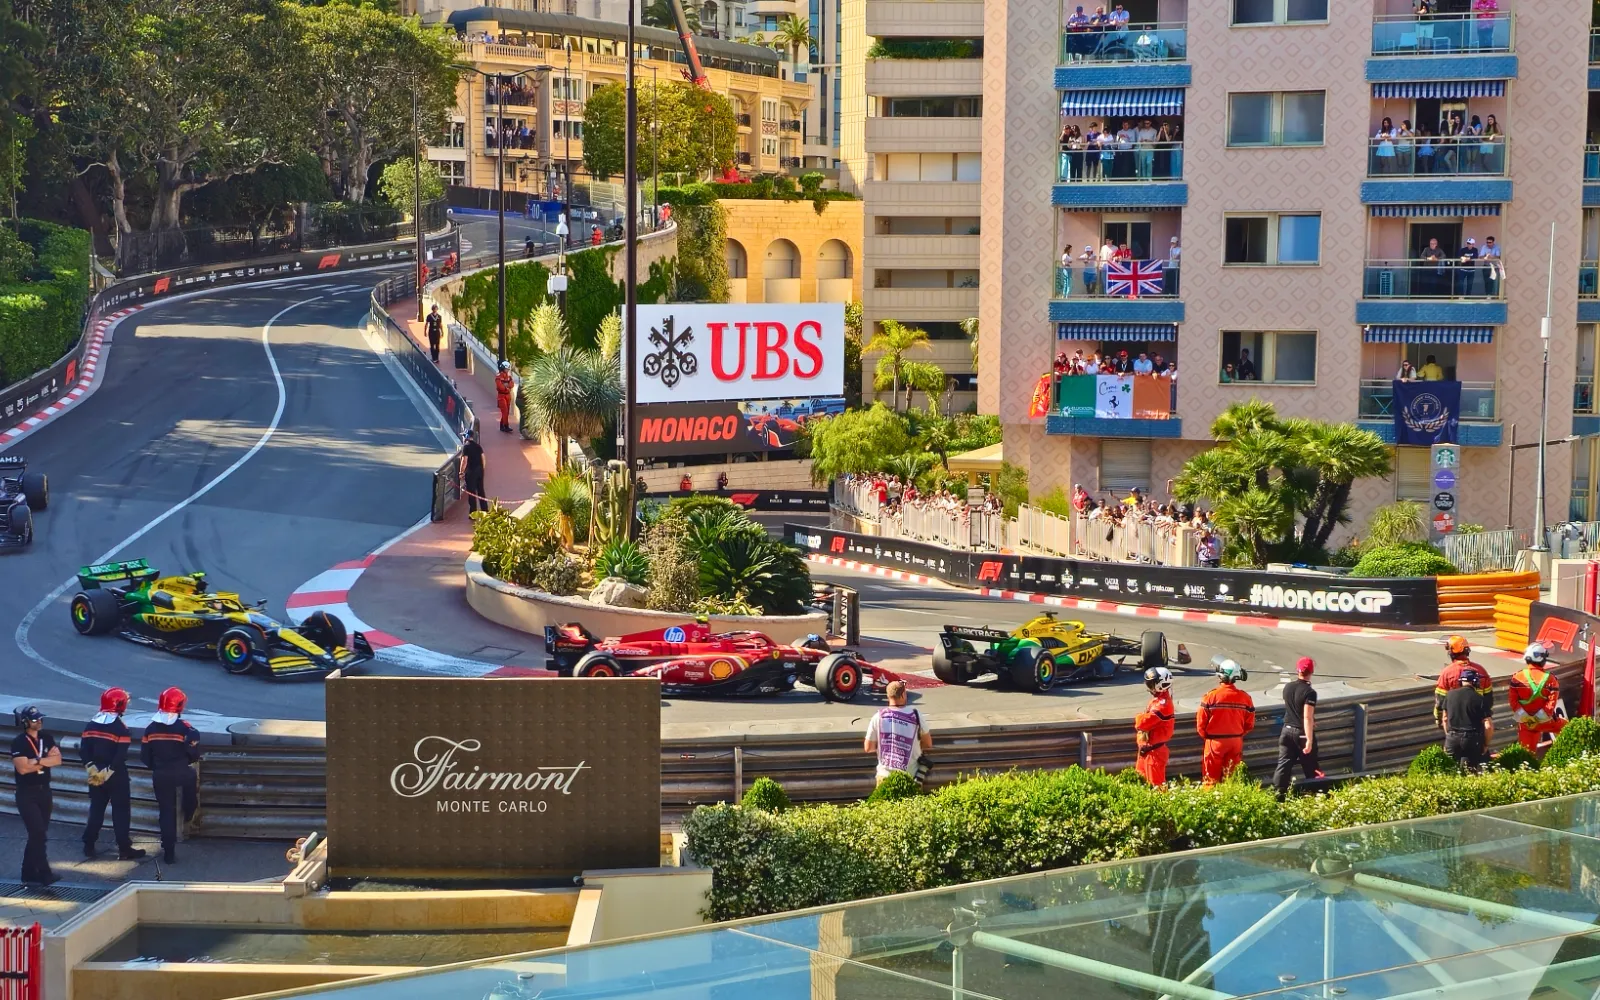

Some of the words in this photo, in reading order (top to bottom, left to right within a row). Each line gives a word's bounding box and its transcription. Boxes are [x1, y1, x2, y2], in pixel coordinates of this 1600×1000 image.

[706, 320, 825, 382] UBS
[639, 415, 738, 443] MONACO
[1151, 584, 1175, 593] crypto.com
[1190, 585, 1206, 595] MSC
[1250, 583, 1393, 613] #MonacoGP
[669, 629, 683, 643] hp
[952, 624, 1001, 637] DARKTRACE
[614, 647, 651, 656] Santander
[390, 735, 592, 798] Fairmont
[436, 800, 490, 813] MONTE
[498, 800, 548, 813] CARLO
